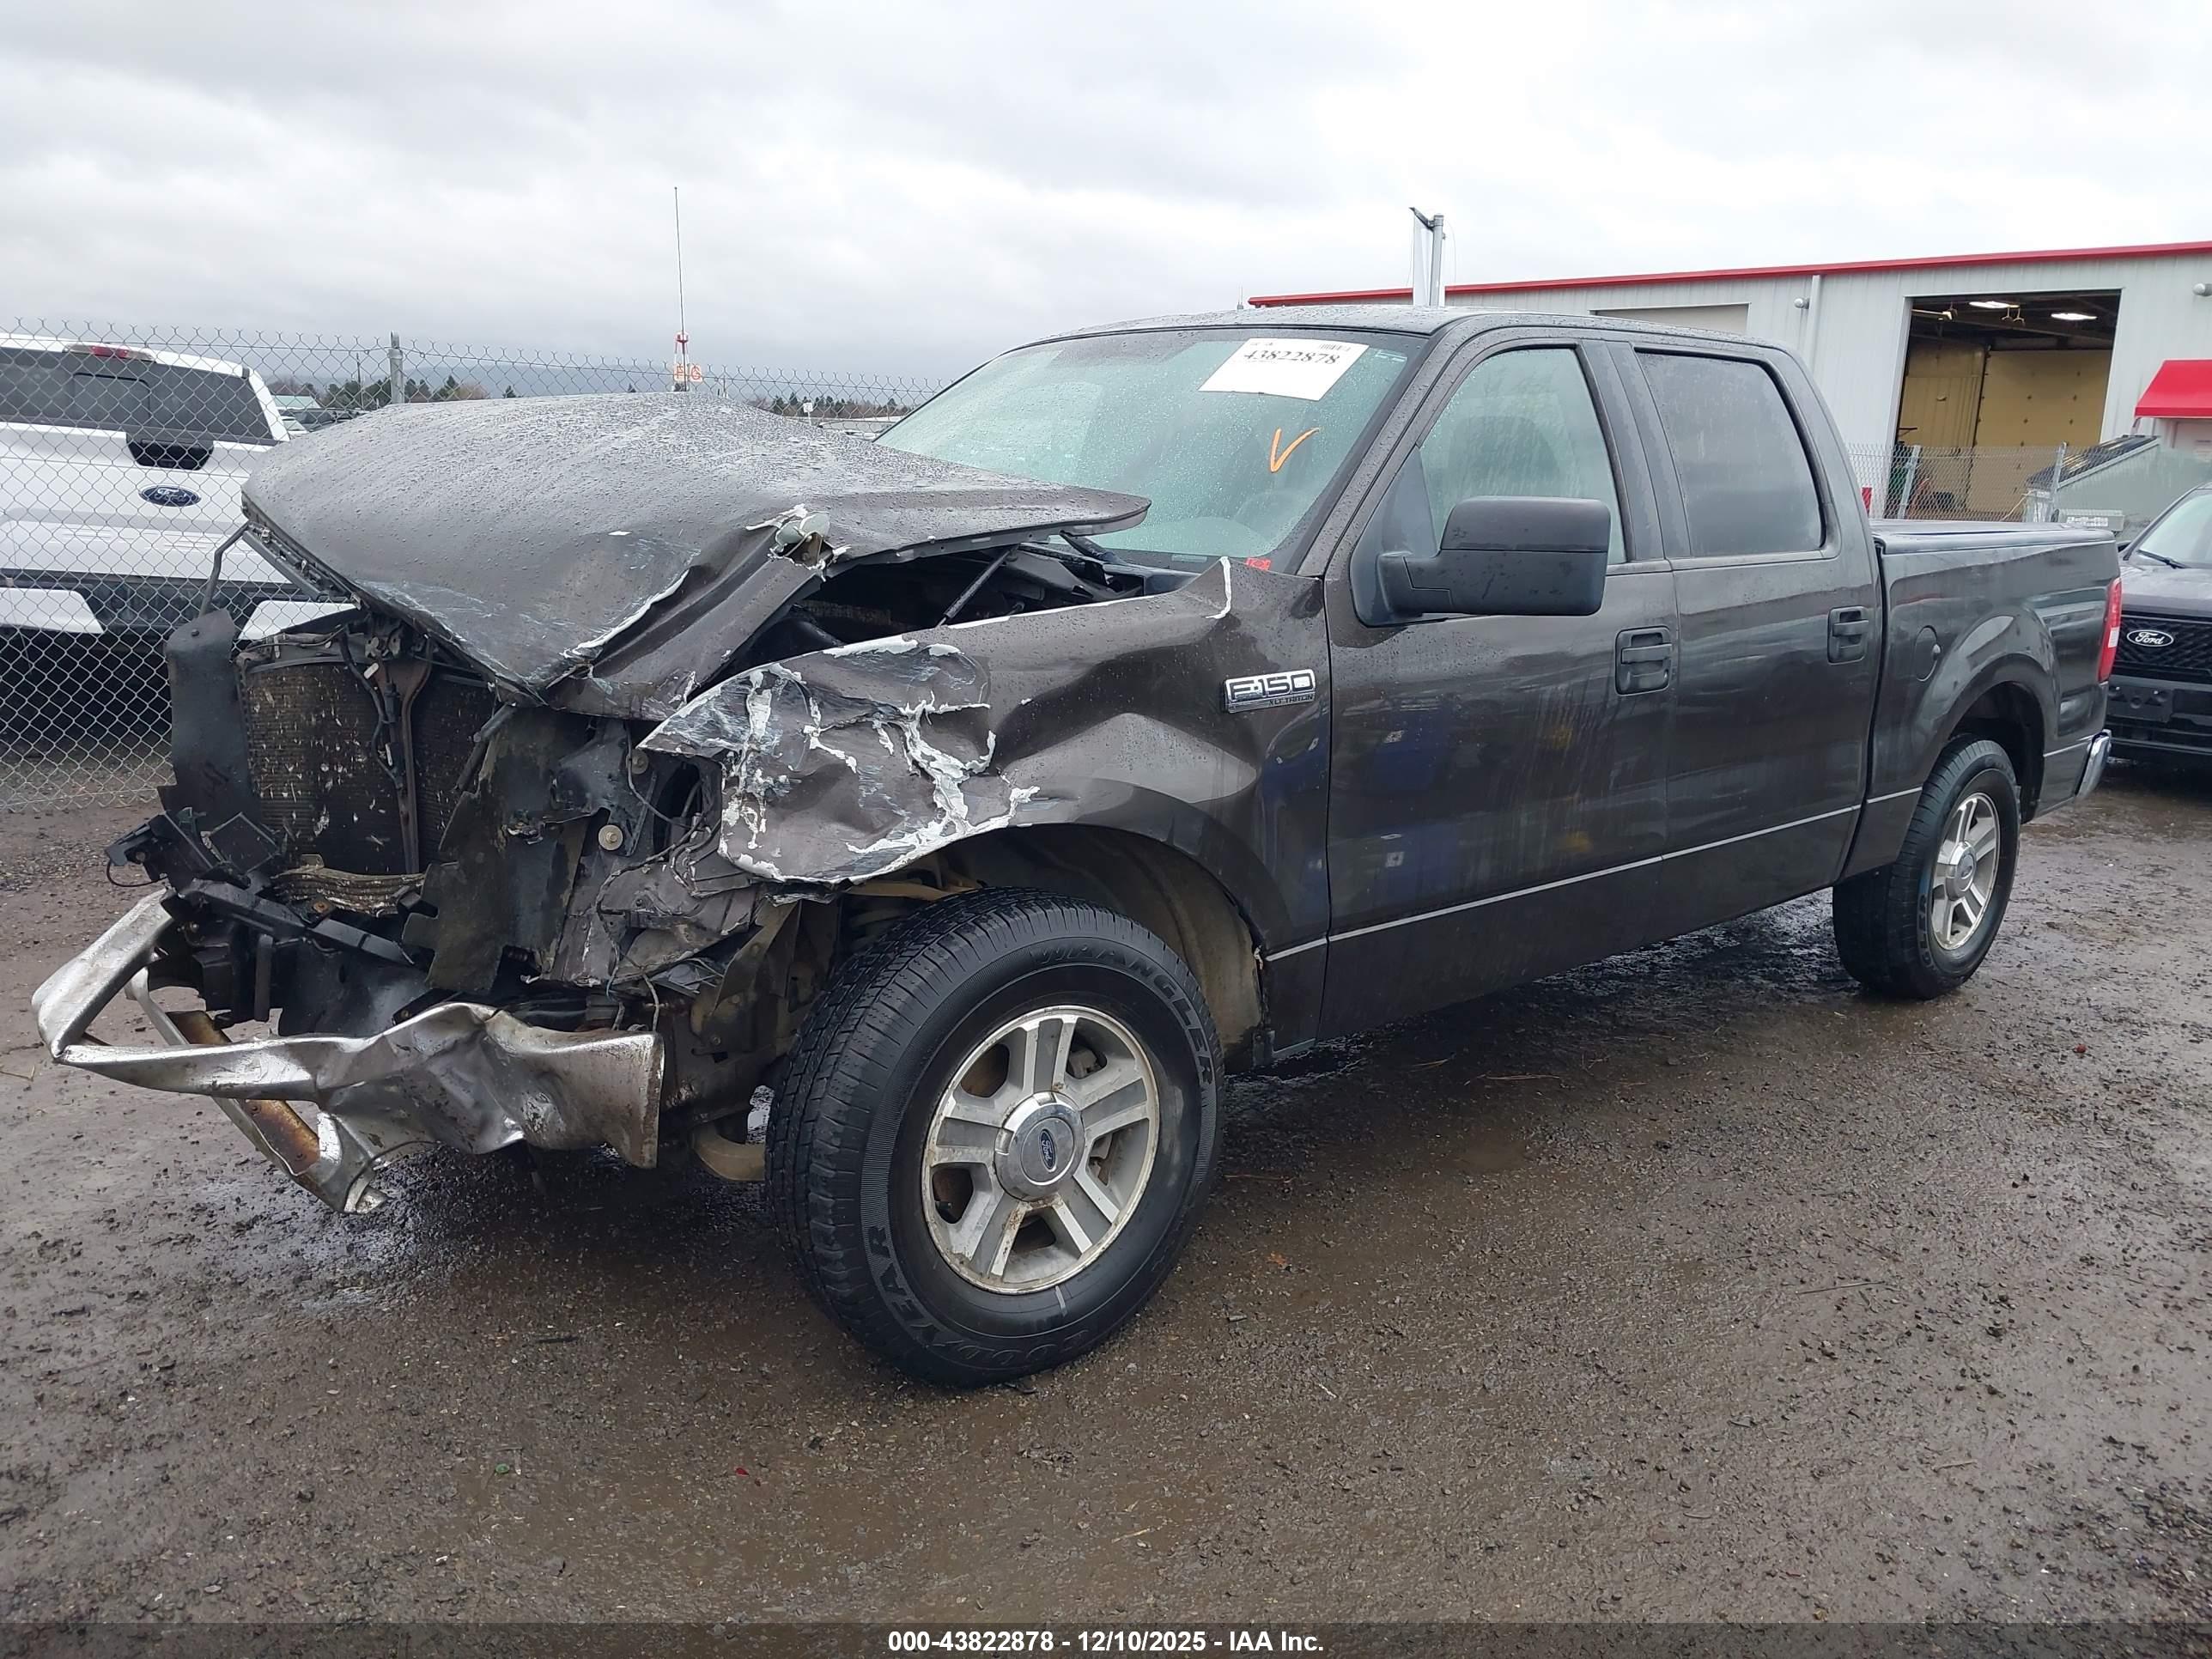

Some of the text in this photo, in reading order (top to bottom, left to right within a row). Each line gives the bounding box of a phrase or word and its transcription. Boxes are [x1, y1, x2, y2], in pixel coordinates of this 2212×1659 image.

[1244, 349, 1340, 365] 43822878
[2135, 631, 2165, 645] Ford
[1041, 1139, 1053, 1161] Ford
